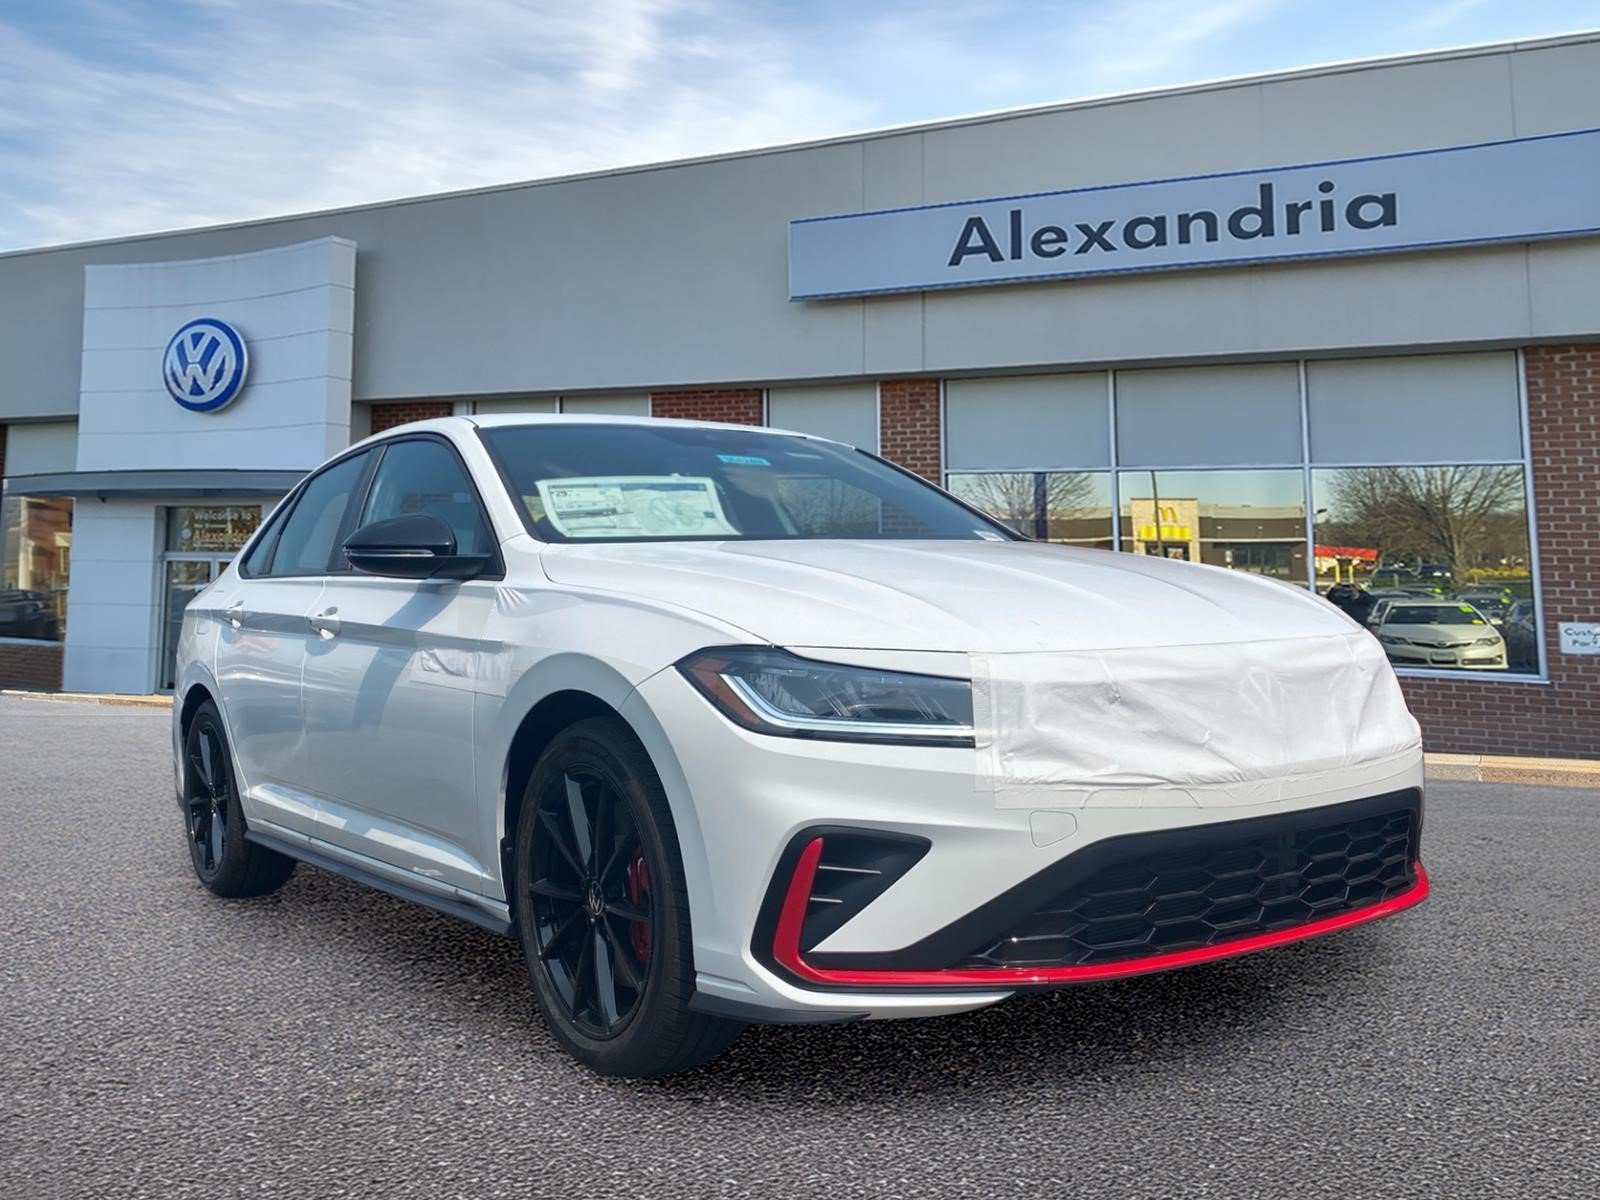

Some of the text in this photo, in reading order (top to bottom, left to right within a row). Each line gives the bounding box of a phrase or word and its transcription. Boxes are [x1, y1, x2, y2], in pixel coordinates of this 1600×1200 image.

[947, 180, 1398, 267] Alexandria
[166, 325, 237, 404] VW
[194, 510, 239, 520] Welcome
